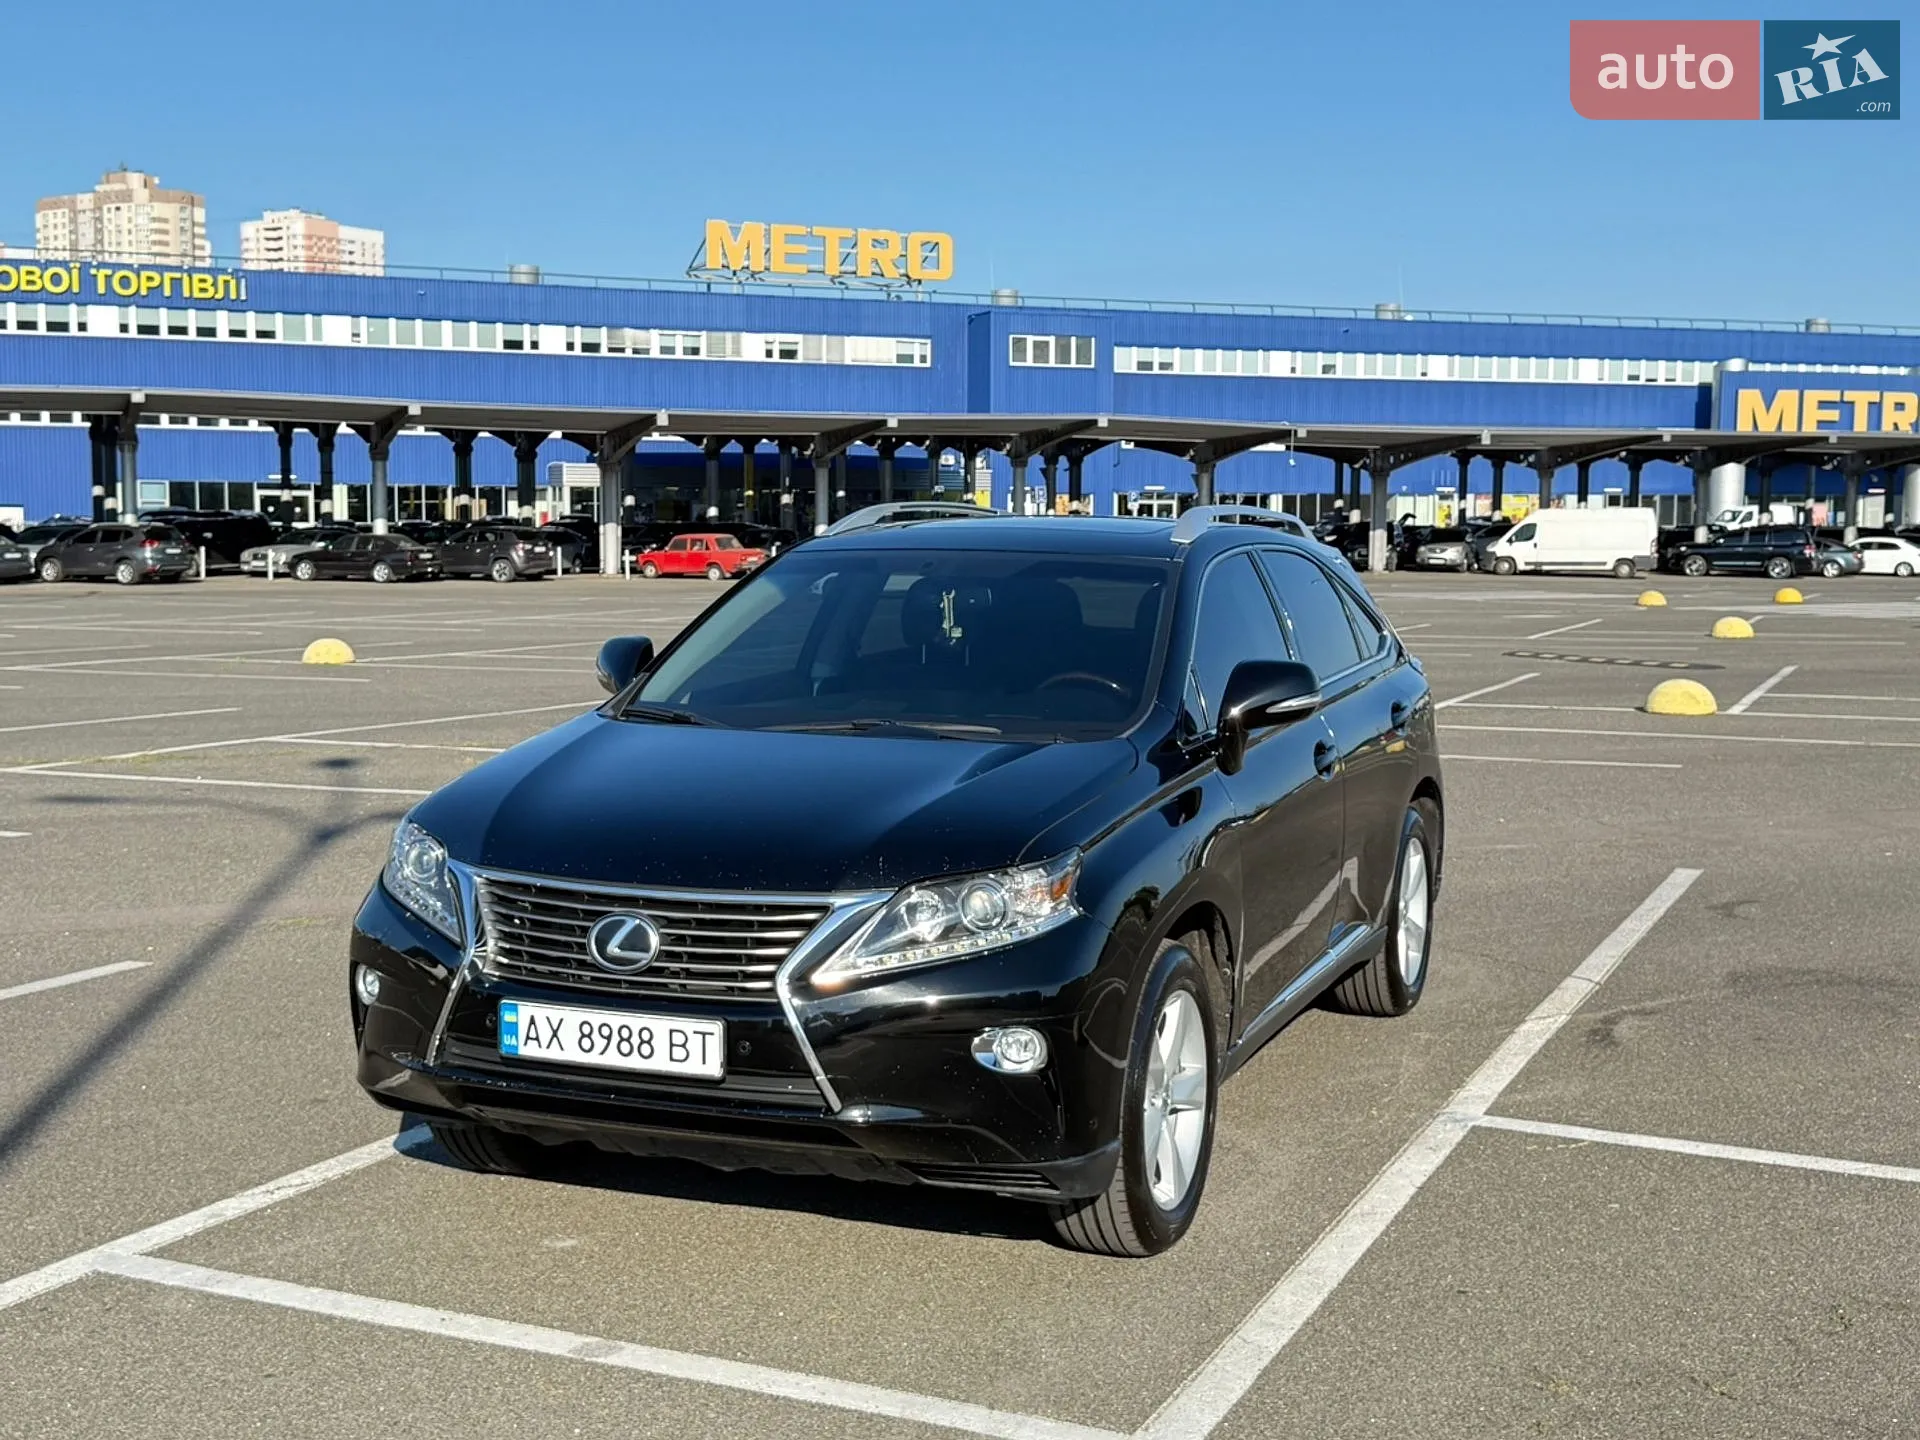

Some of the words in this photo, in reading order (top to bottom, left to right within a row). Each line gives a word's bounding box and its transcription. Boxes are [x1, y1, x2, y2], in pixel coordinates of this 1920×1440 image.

[705, 218, 954, 281] METRO
[90, 267, 247, 300] ТОРГІВЛІ
[503, 1034, 518, 1046] UA
[523, 1014, 564, 1051] AX
[577, 1020, 655, 1060] 8988
[669, 1029, 715, 1065] BT
